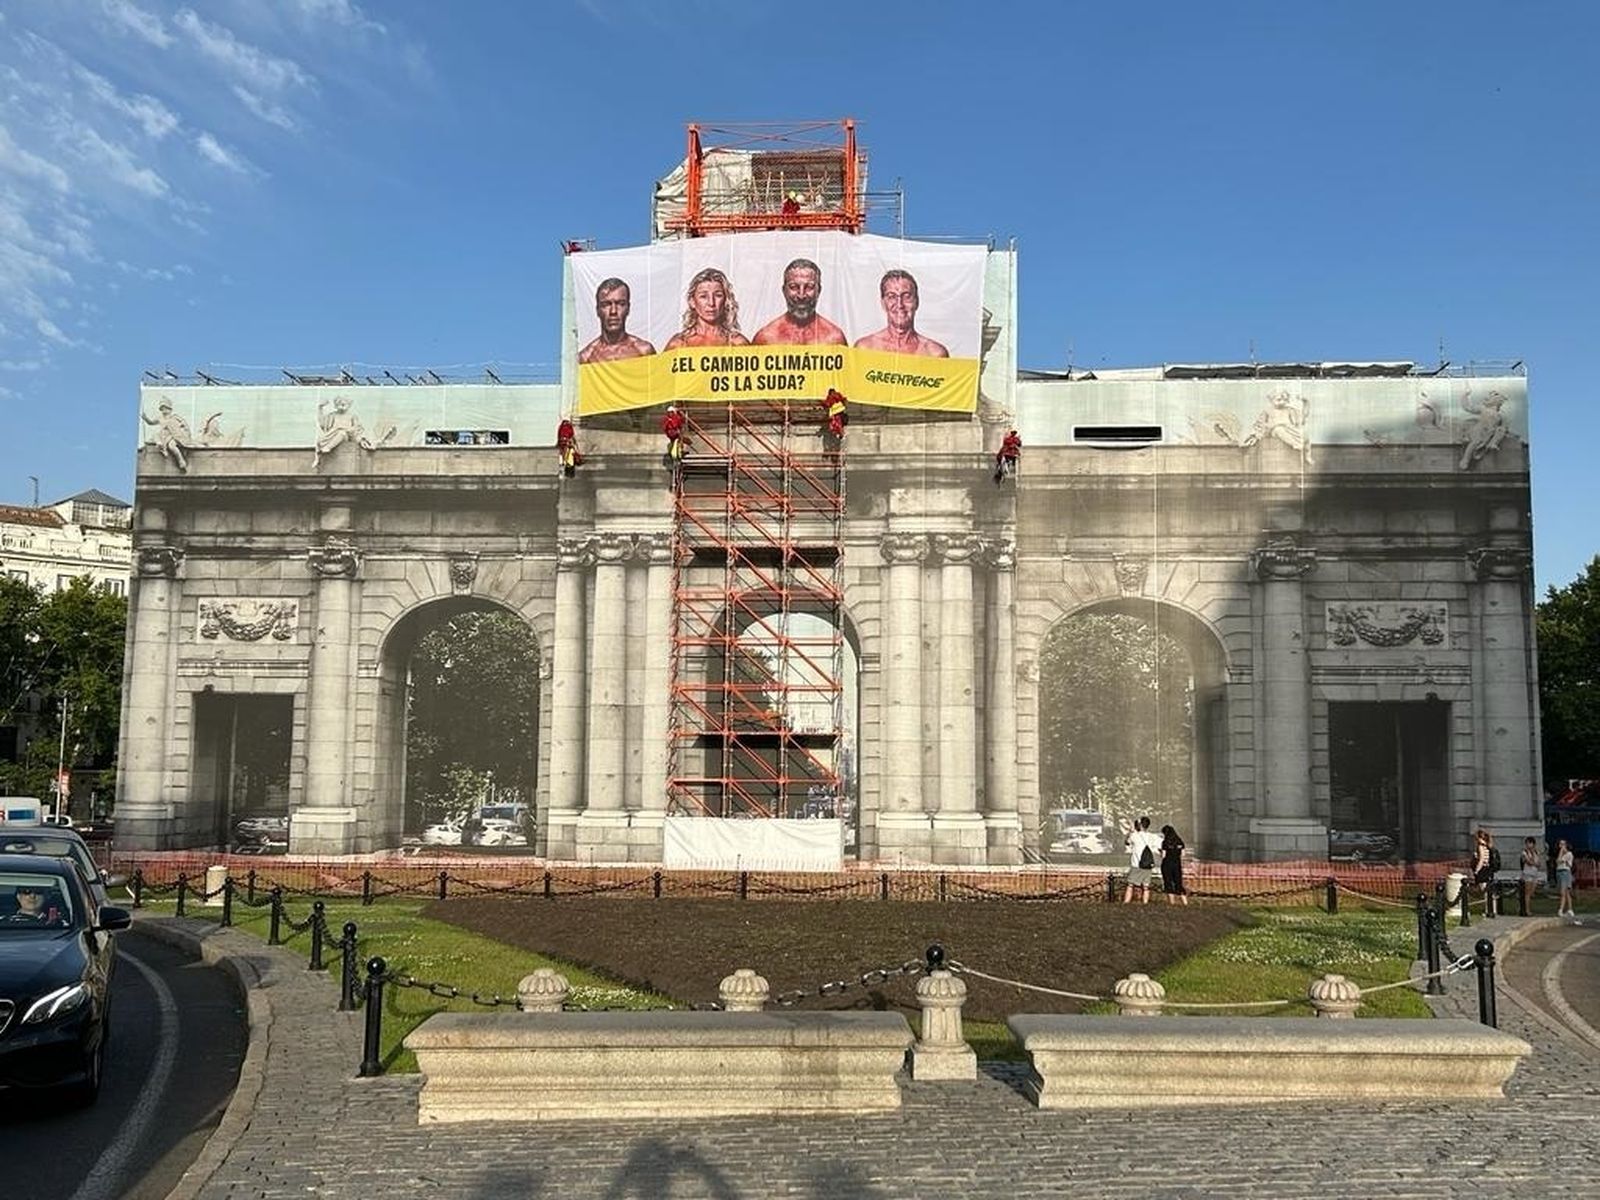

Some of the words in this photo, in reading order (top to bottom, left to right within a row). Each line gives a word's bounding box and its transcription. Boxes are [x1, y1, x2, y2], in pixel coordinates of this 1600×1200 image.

[671, 356, 696, 373] ¿EL
[701, 356, 759, 372] CAMBIO
[765, 352, 843, 371] CLIMÁTICO
[711, 376, 730, 392] OS
[735, 376, 752, 391] LA
[757, 375, 805, 390] SUDA?
[865, 370, 945, 388] GREENPEACE
